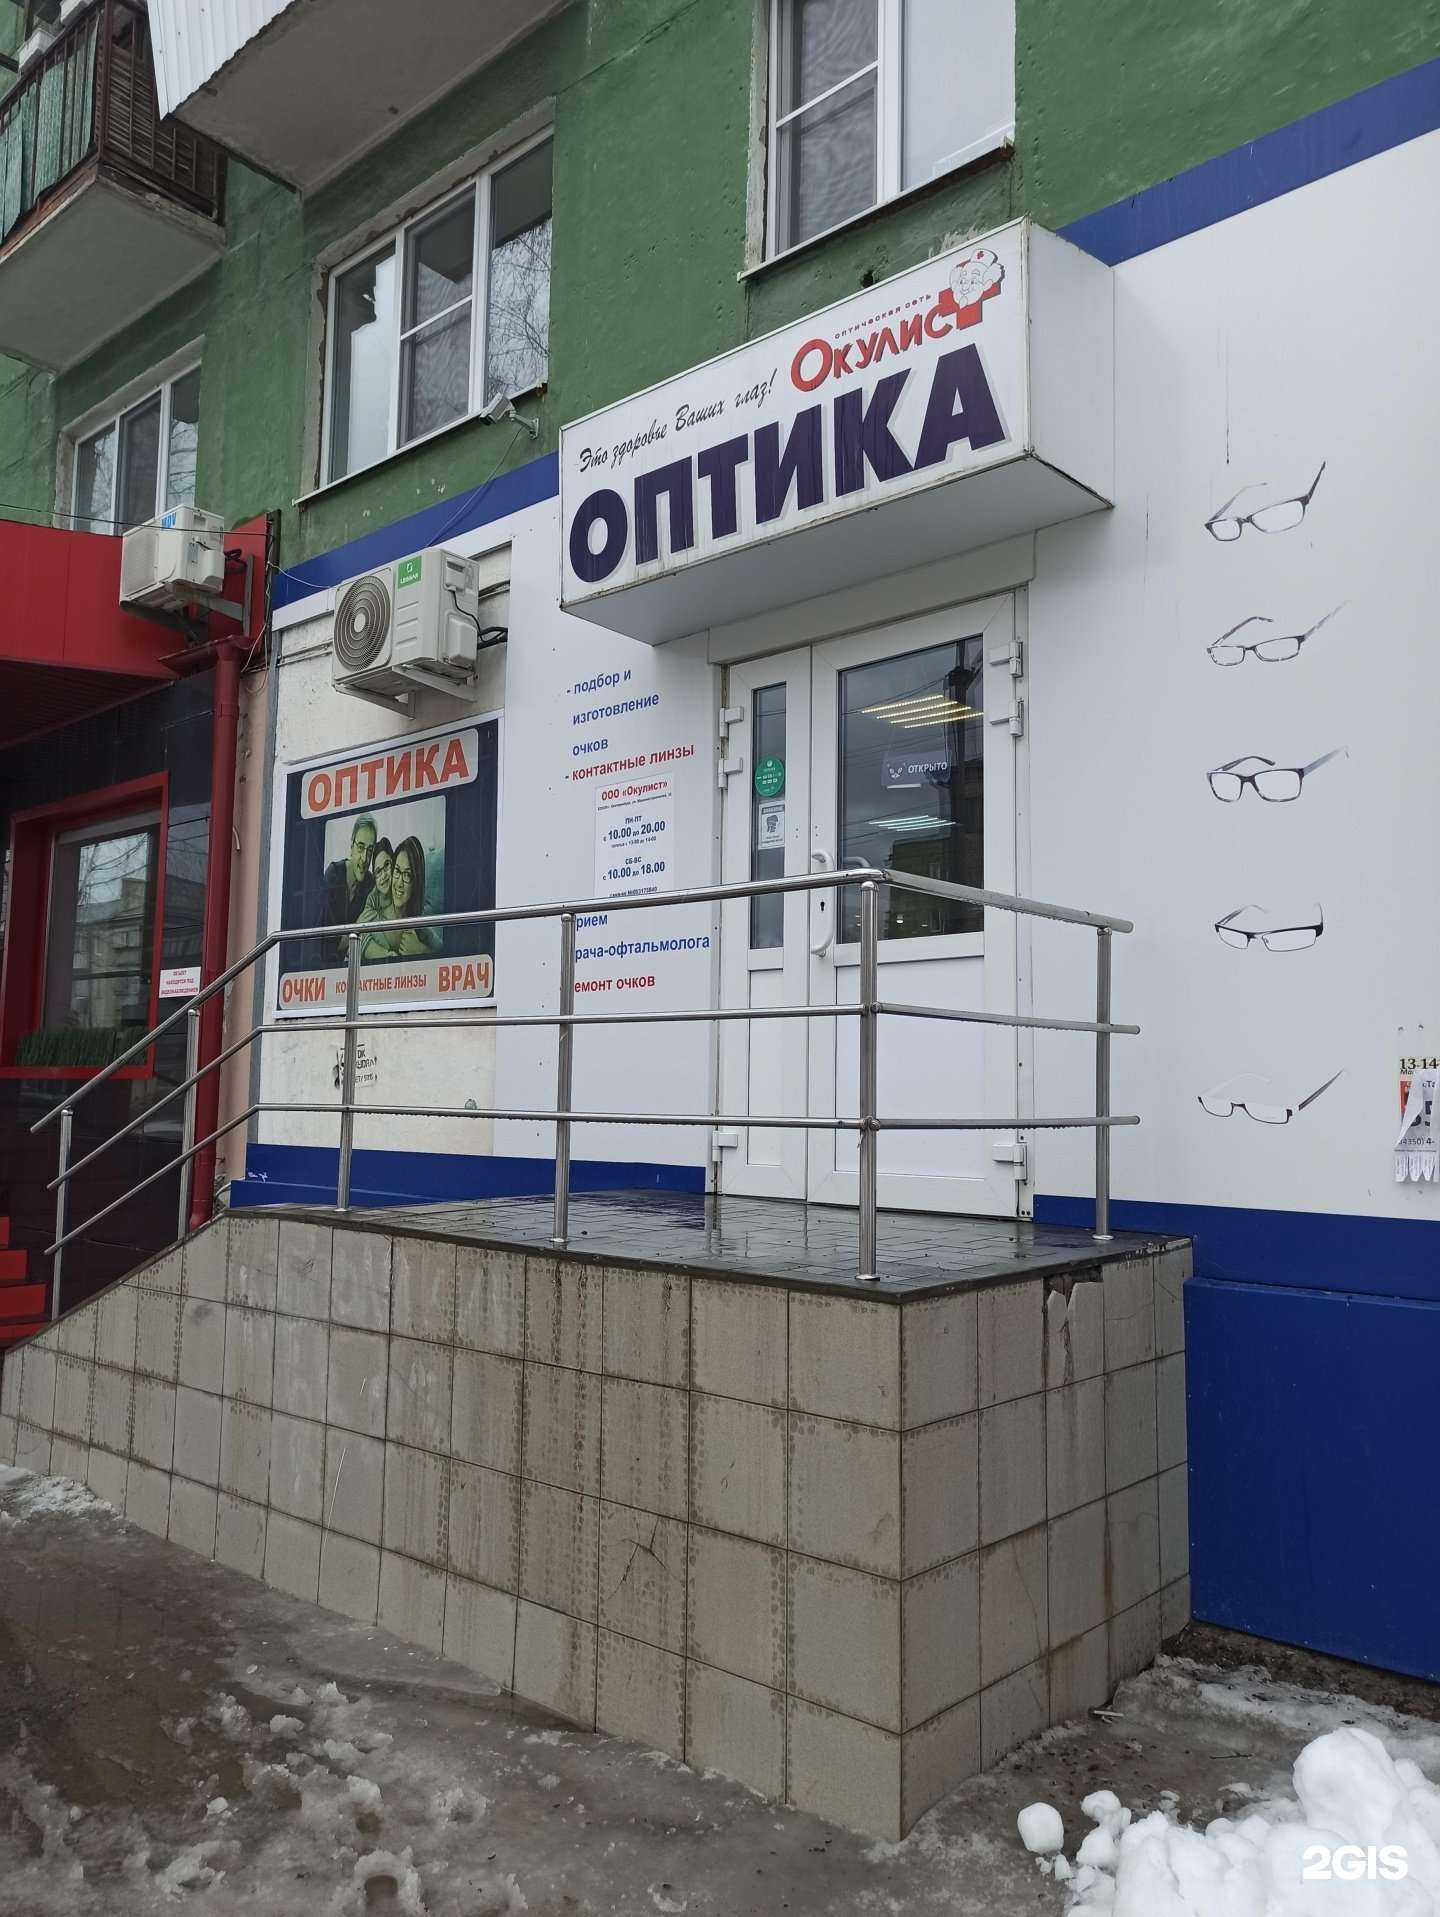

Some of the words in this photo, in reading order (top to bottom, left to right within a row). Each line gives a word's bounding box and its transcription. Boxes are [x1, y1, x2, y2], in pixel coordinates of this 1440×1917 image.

[580, 447, 608, 472] Это
[611, 419, 667, 469] здоровье
[675, 404, 725, 431] Ваших
[569, 343, 1007, 582] ОПТИКА
[574, 672, 620, 694] подбор
[624, 669, 631, 680] и
[573, 694, 660, 725] изготовление
[573, 739, 609, 756] очков
[307, 738, 469, 812] ОПТИКА
[572, 755, 646, 781] контактные
[650, 745, 694, 765] линзы
[908, 761, 947, 774] ОТКРЫТО
[602, 789, 620, 801] ООО
[622, 781, 668, 796] «Окулист»
[608, 827, 631, 840] 10.00
[641, 821, 666, 834] 20.00
[608, 867, 631, 880] 10.00
[641, 862, 665, 874] 18.00
[575, 914, 608, 931] рием
[575, 936, 710, 962] рача-офтальмолога
[282, 977, 326, 1002] ОЧКИ
[336, 977, 392, 993] КОАКТНЫЕ
[394, 974, 427, 989] ЛИНЗЫ
[438, 962, 489, 992] ВРАЧ
[574, 979, 612, 993] емонт
[616, 976, 655, 990] очков
